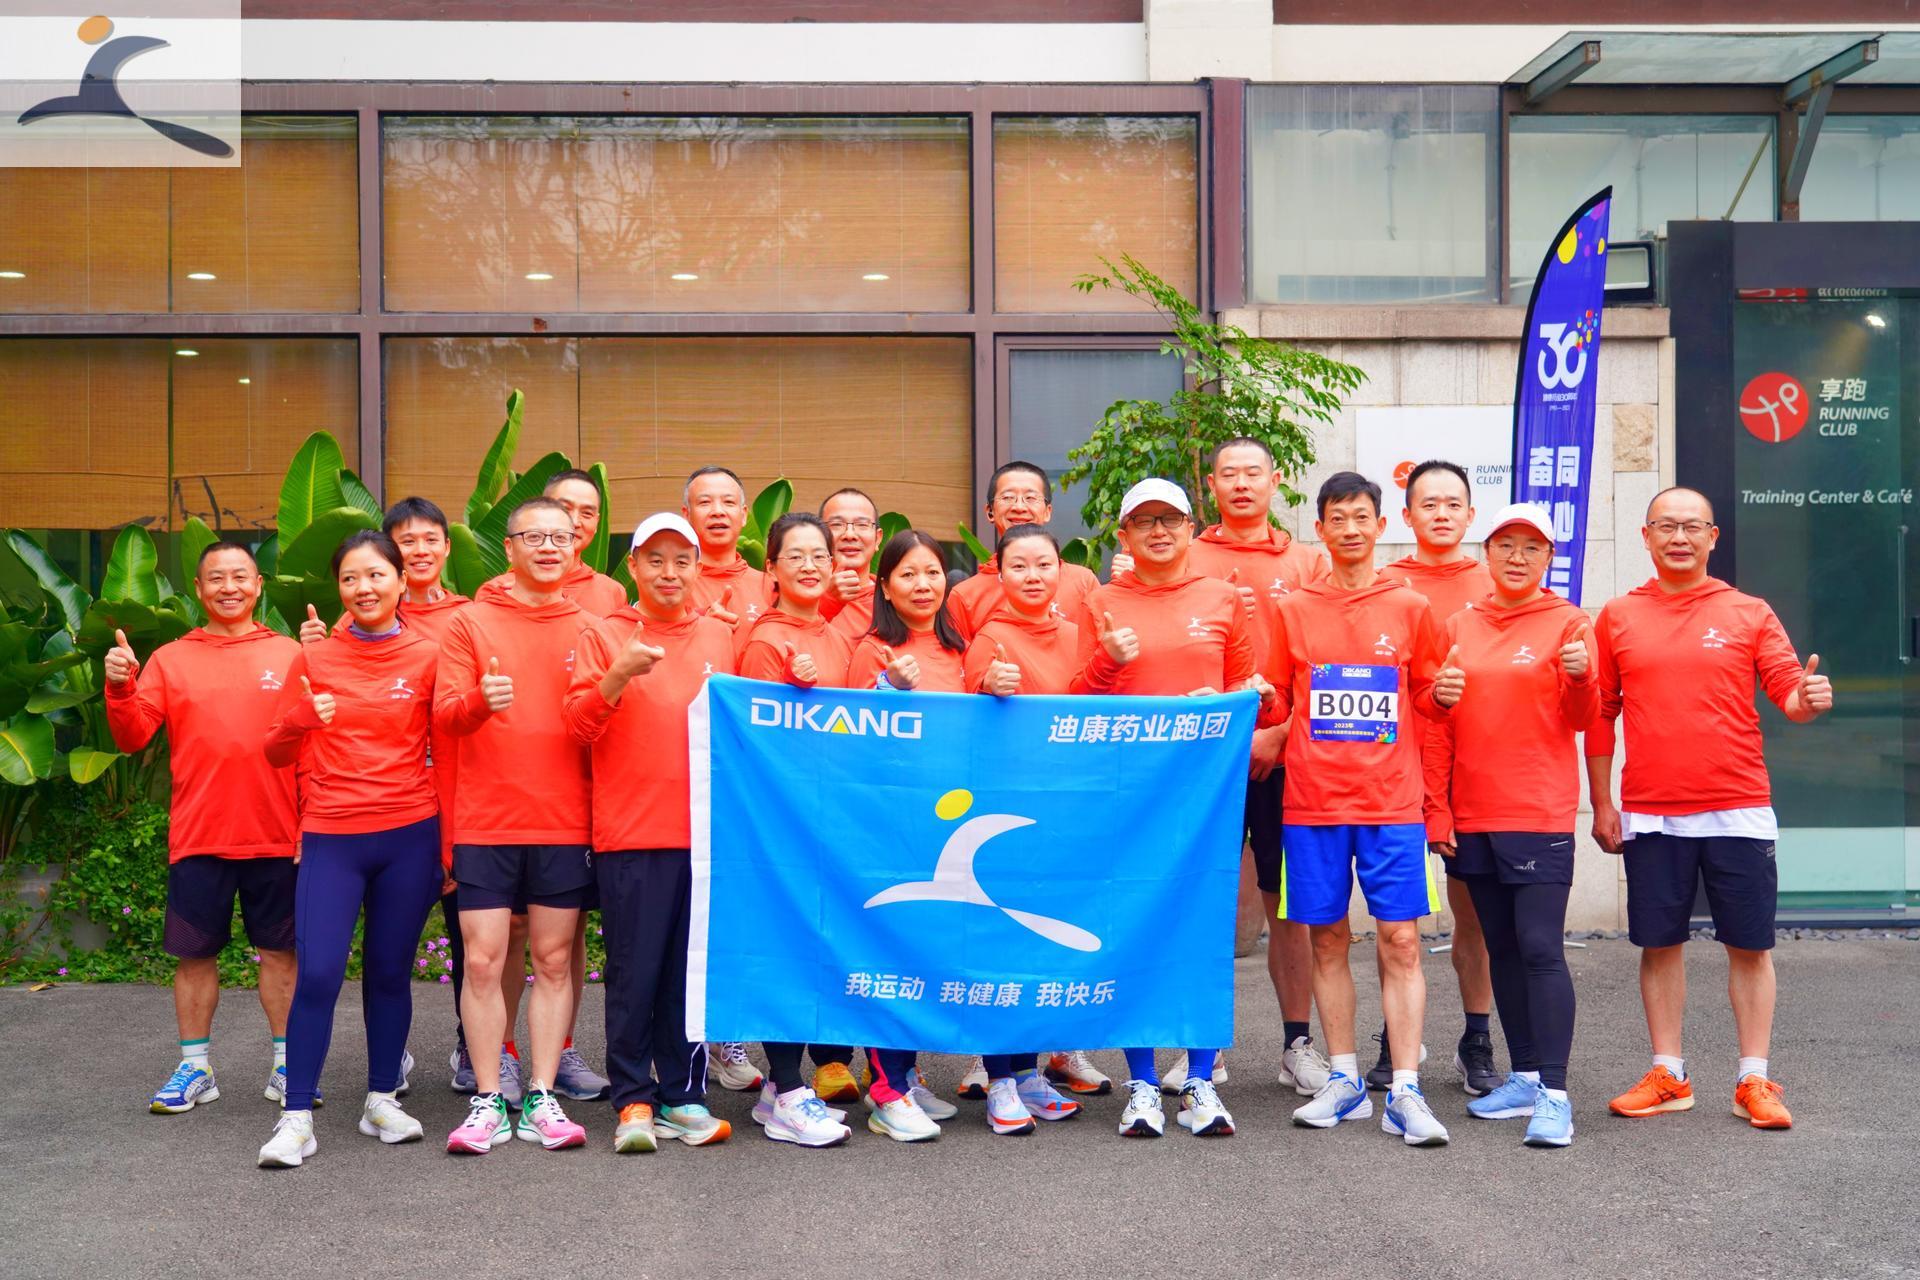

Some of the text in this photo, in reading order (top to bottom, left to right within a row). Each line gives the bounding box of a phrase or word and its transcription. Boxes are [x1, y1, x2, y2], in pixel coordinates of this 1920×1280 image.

[1538, 323, 1587, 389] 30
[1819, 378, 1867, 402] 享跑
[1819, 407, 1889, 420] RUNNING
[1819, 423, 1857, 436] CLUB
[1476, 476, 1503, 485] CLUB
[1742, 489, 1912, 507] Training Center & Café
[1318, 693, 1391, 718] B004
[751, 697, 922, 739] DIKANG
[1048, 711, 1232, 743] 迪康药业跑团
[845, 972, 1116, 1008] 我运动 我健康 我快乐
